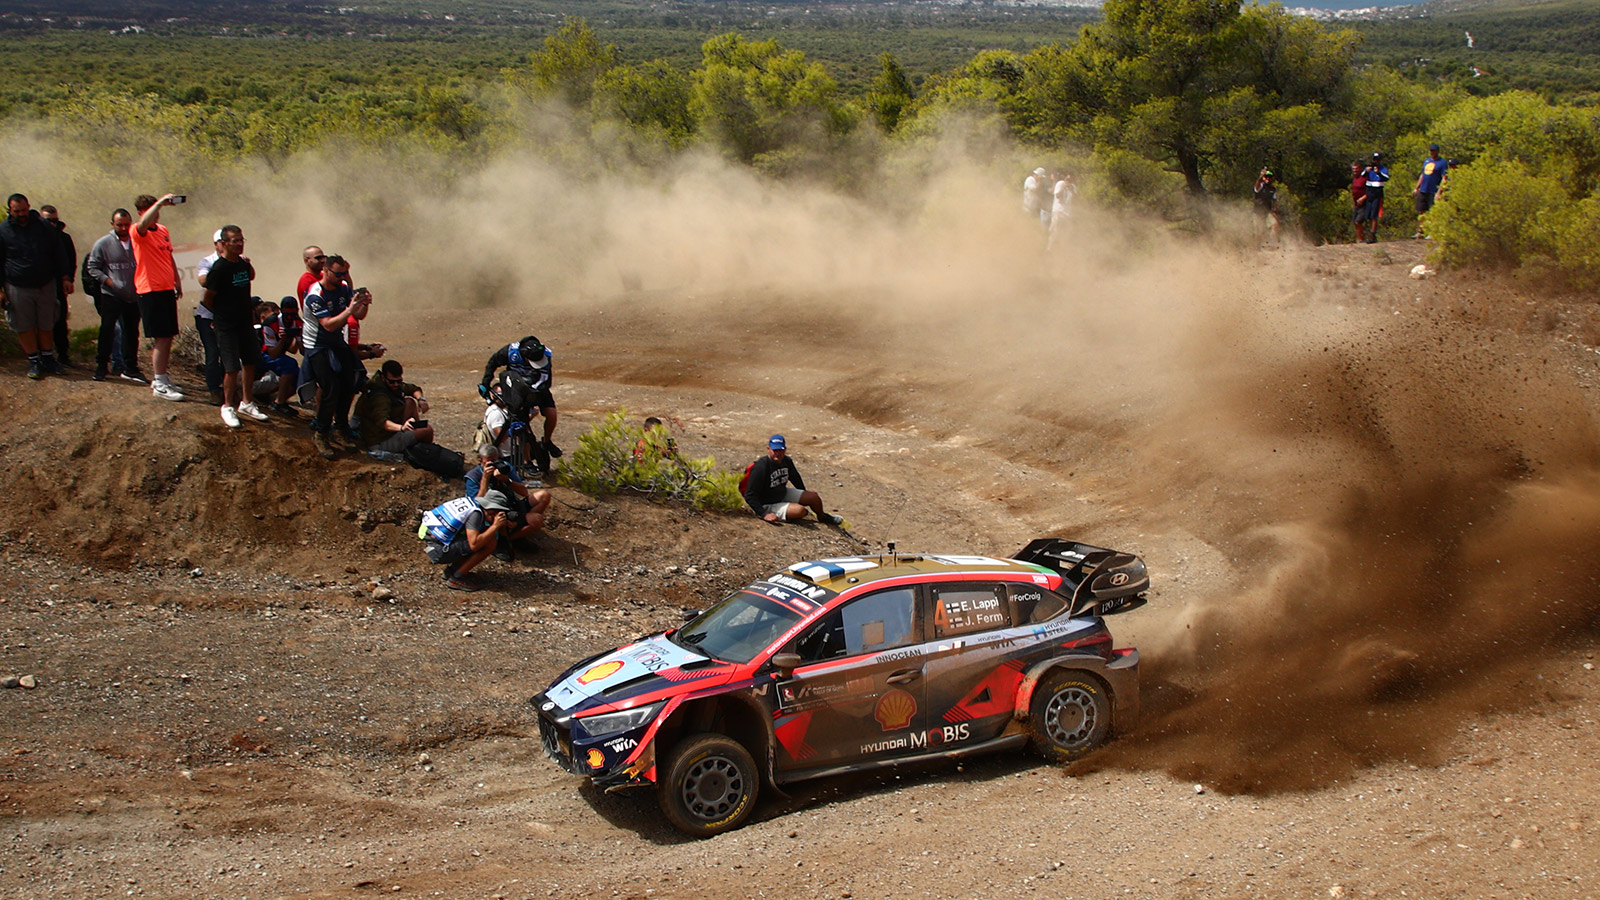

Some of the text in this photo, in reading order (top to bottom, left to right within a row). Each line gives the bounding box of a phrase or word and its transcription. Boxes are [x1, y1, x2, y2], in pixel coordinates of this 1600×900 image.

[961, 596, 1000, 612] E. Lappi
[934, 599, 950, 630] 4
[964, 612, 1004, 626] J. Ferm
[766, 607, 827, 654] motorsport.hyundai.com
[1044, 617, 1072, 630] HYUNDAI
[1045, 626, 1069, 636] STEEL
[875, 648, 922, 663] INNOCEAN
[1053, 681, 1097, 694] SCORPION
[612, 738, 639, 753] WIA
[860, 723, 971, 754] HYUNDAI MOBIS
